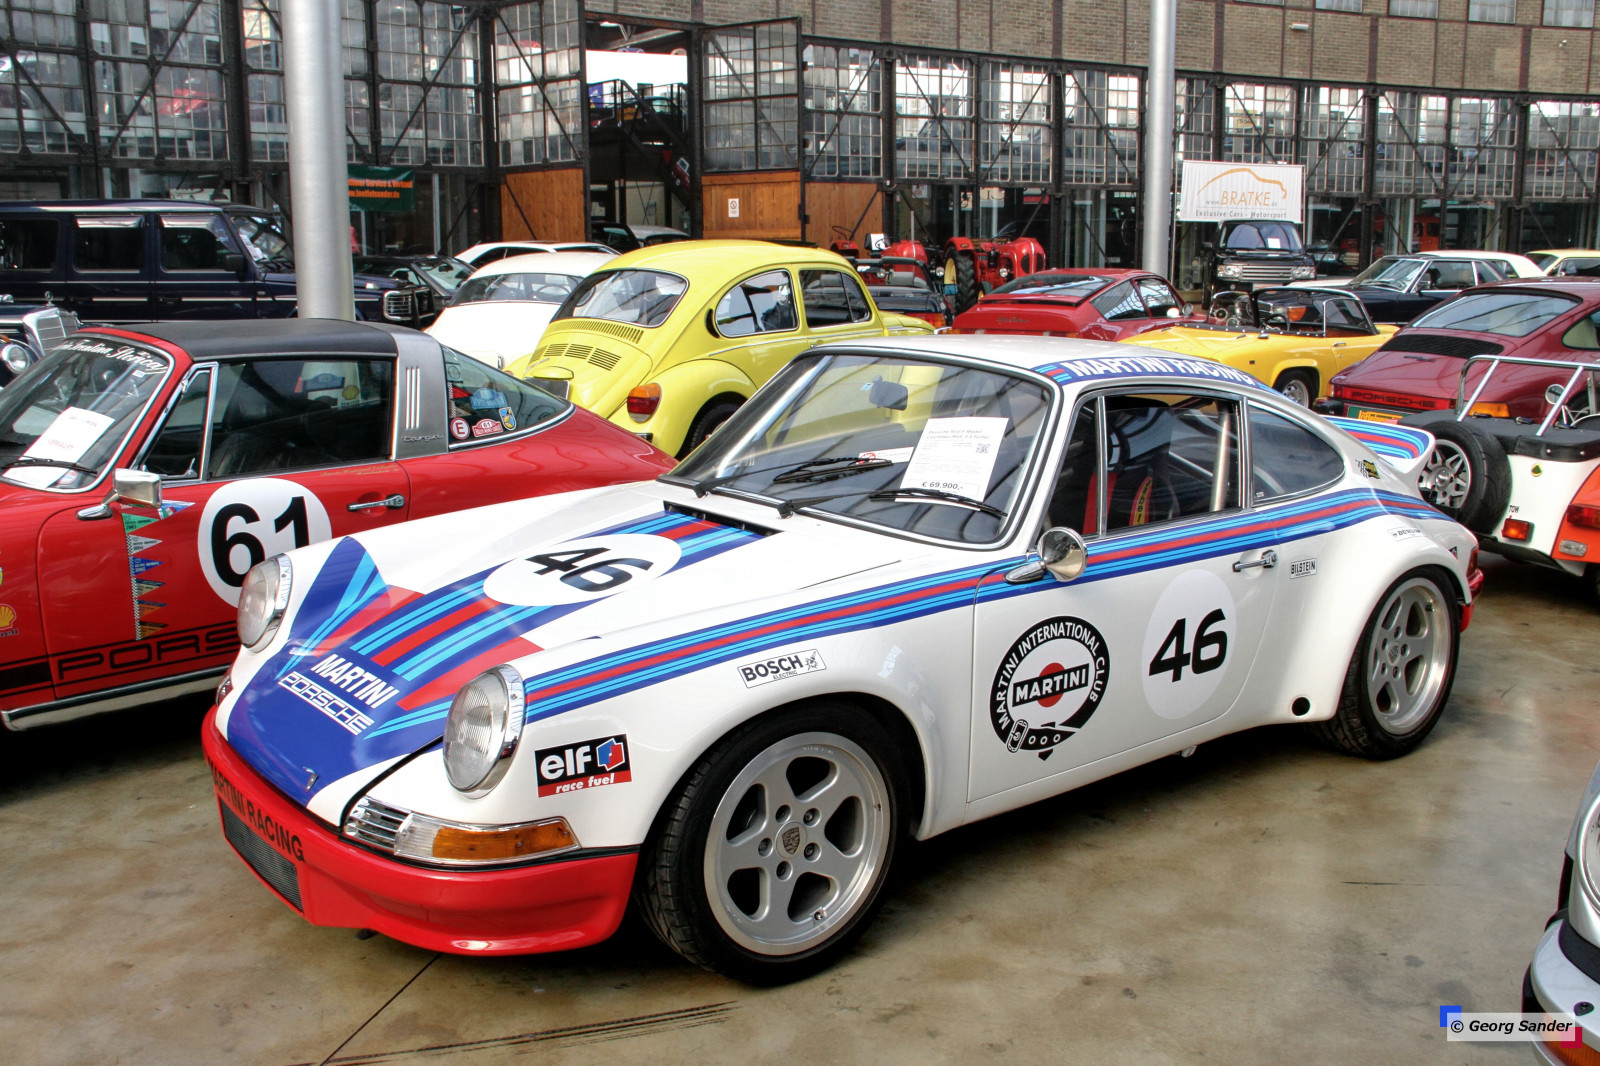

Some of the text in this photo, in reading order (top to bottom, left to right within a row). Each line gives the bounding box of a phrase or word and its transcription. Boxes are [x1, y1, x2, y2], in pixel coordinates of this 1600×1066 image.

[1195, 209, 1227, 217] Exclusive
[1250, 211, 1287, 219] Motorsport
[1060, 357, 1257, 386] MARTINI RACING
[1351, 391, 1435, 408] PORSCHE
[455, 422, 466, 435] E
[929, 481, 964, 491] 69.900,-
[1509, 505, 1520, 513] TOW
[210, 495, 311, 588] 61
[524, 546, 655, 592] 46
[1290, 560, 1316, 574] BILSTEIN
[1148, 607, 1228, 683] 46
[310, 653, 400, 709] MARTINI
[741, 654, 804, 682] BOSCH
[773, 669, 798, 680] ELECTRIC
[996, 621, 1106, 731] MARTINI INTERNATIONAL CLUB
[1015, 668, 1087, 703] MARTINI
[279, 672, 372, 734] PORSCHE
[540, 745, 594, 780] elf
[555, 773, 615, 794] race fuel
[208, 756, 306, 863] MARTINI RACING
